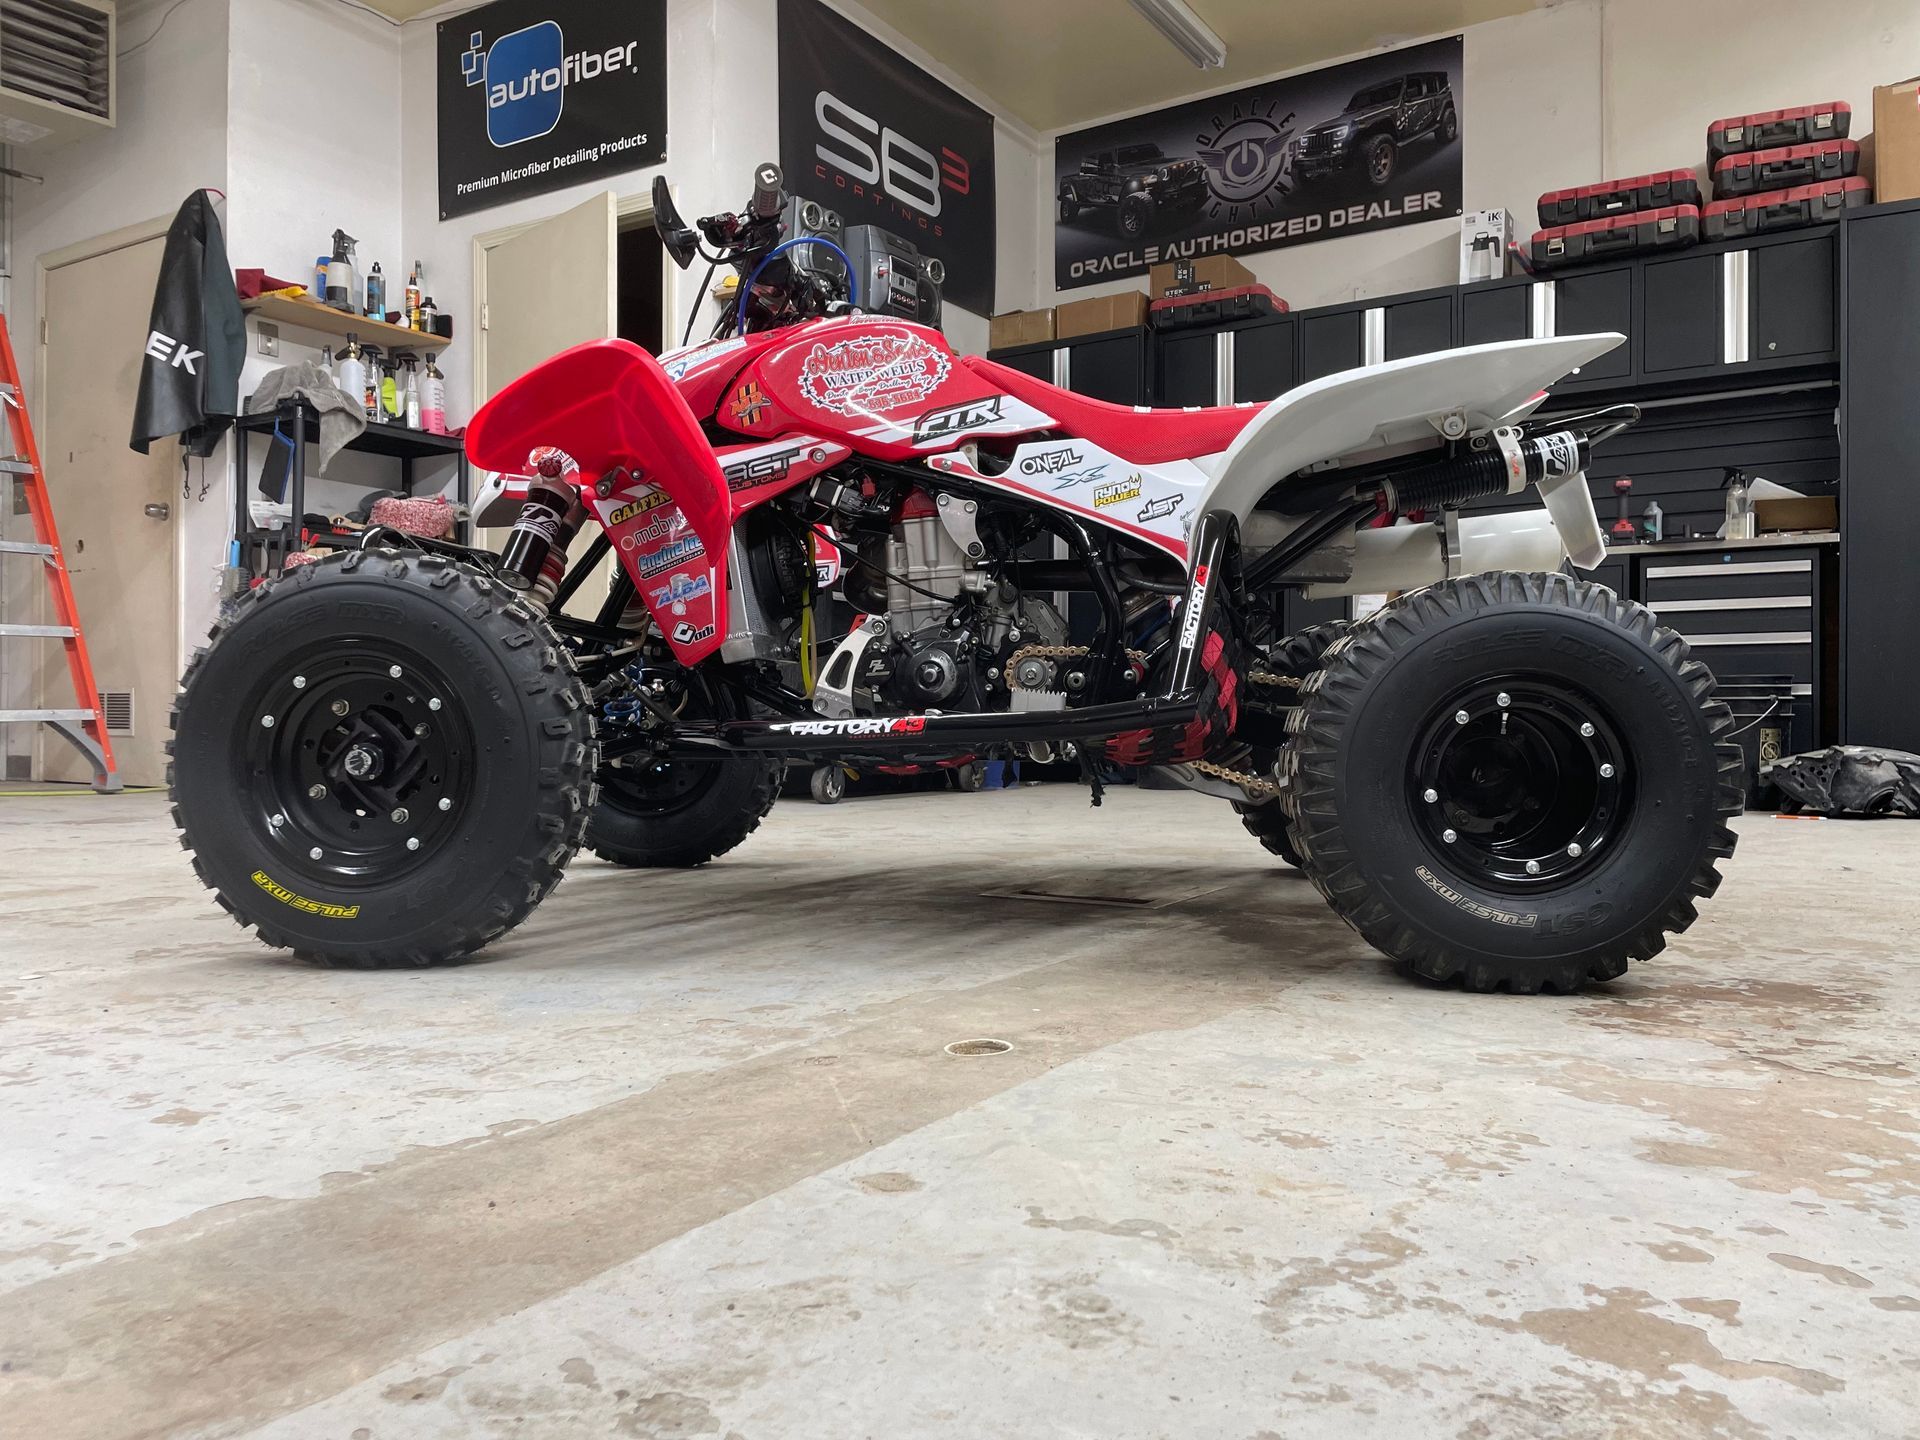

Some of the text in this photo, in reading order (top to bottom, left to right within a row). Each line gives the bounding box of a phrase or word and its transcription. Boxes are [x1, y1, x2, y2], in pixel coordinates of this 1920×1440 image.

[489, 40, 637, 108] autofiber
[457, 133, 648, 195] Premium Microfiber Detailing Products
[815, 91, 969, 217] SB3
[815, 164, 943, 236] COATINGS
[1070, 246, 1158, 279] ORACLE
[1165, 213, 1322, 260] AUTHORIZED
[1329, 190, 1443, 229] DEALER
[145, 330, 205, 376] EK
[825, 360, 925, 388] WATER WELLS
[880, 379, 911, 389] Drilling
[1095, 489, 1140, 508] POWER
[251, 870, 296, 903] MXR
[289, 896, 360, 919] PULSE
[1415, 865, 1538, 928] PULSE MXR
